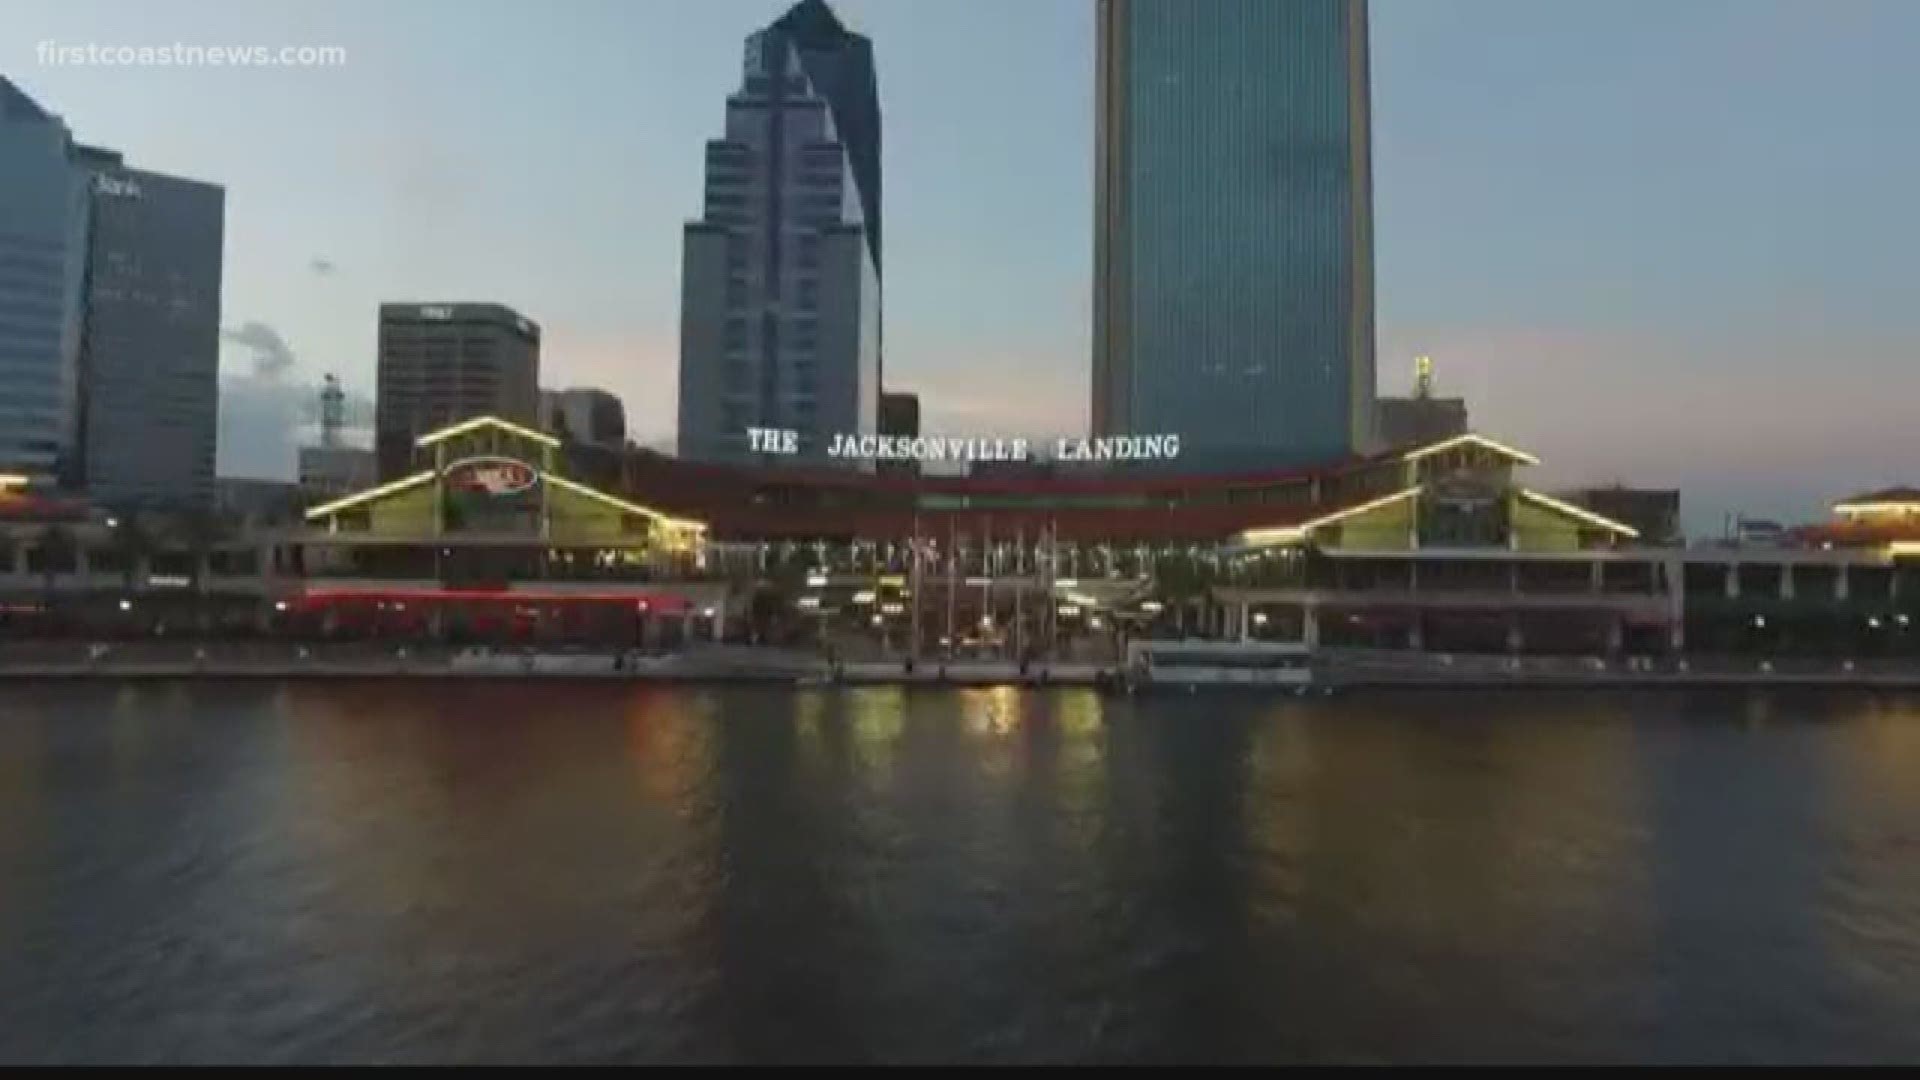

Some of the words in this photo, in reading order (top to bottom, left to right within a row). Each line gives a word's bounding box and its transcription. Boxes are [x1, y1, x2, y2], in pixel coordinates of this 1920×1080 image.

[747, 428, 798, 454] THE
[827, 433, 1028, 461] JACKSONVILLE
[1057, 434, 1180, 460] LANDING
